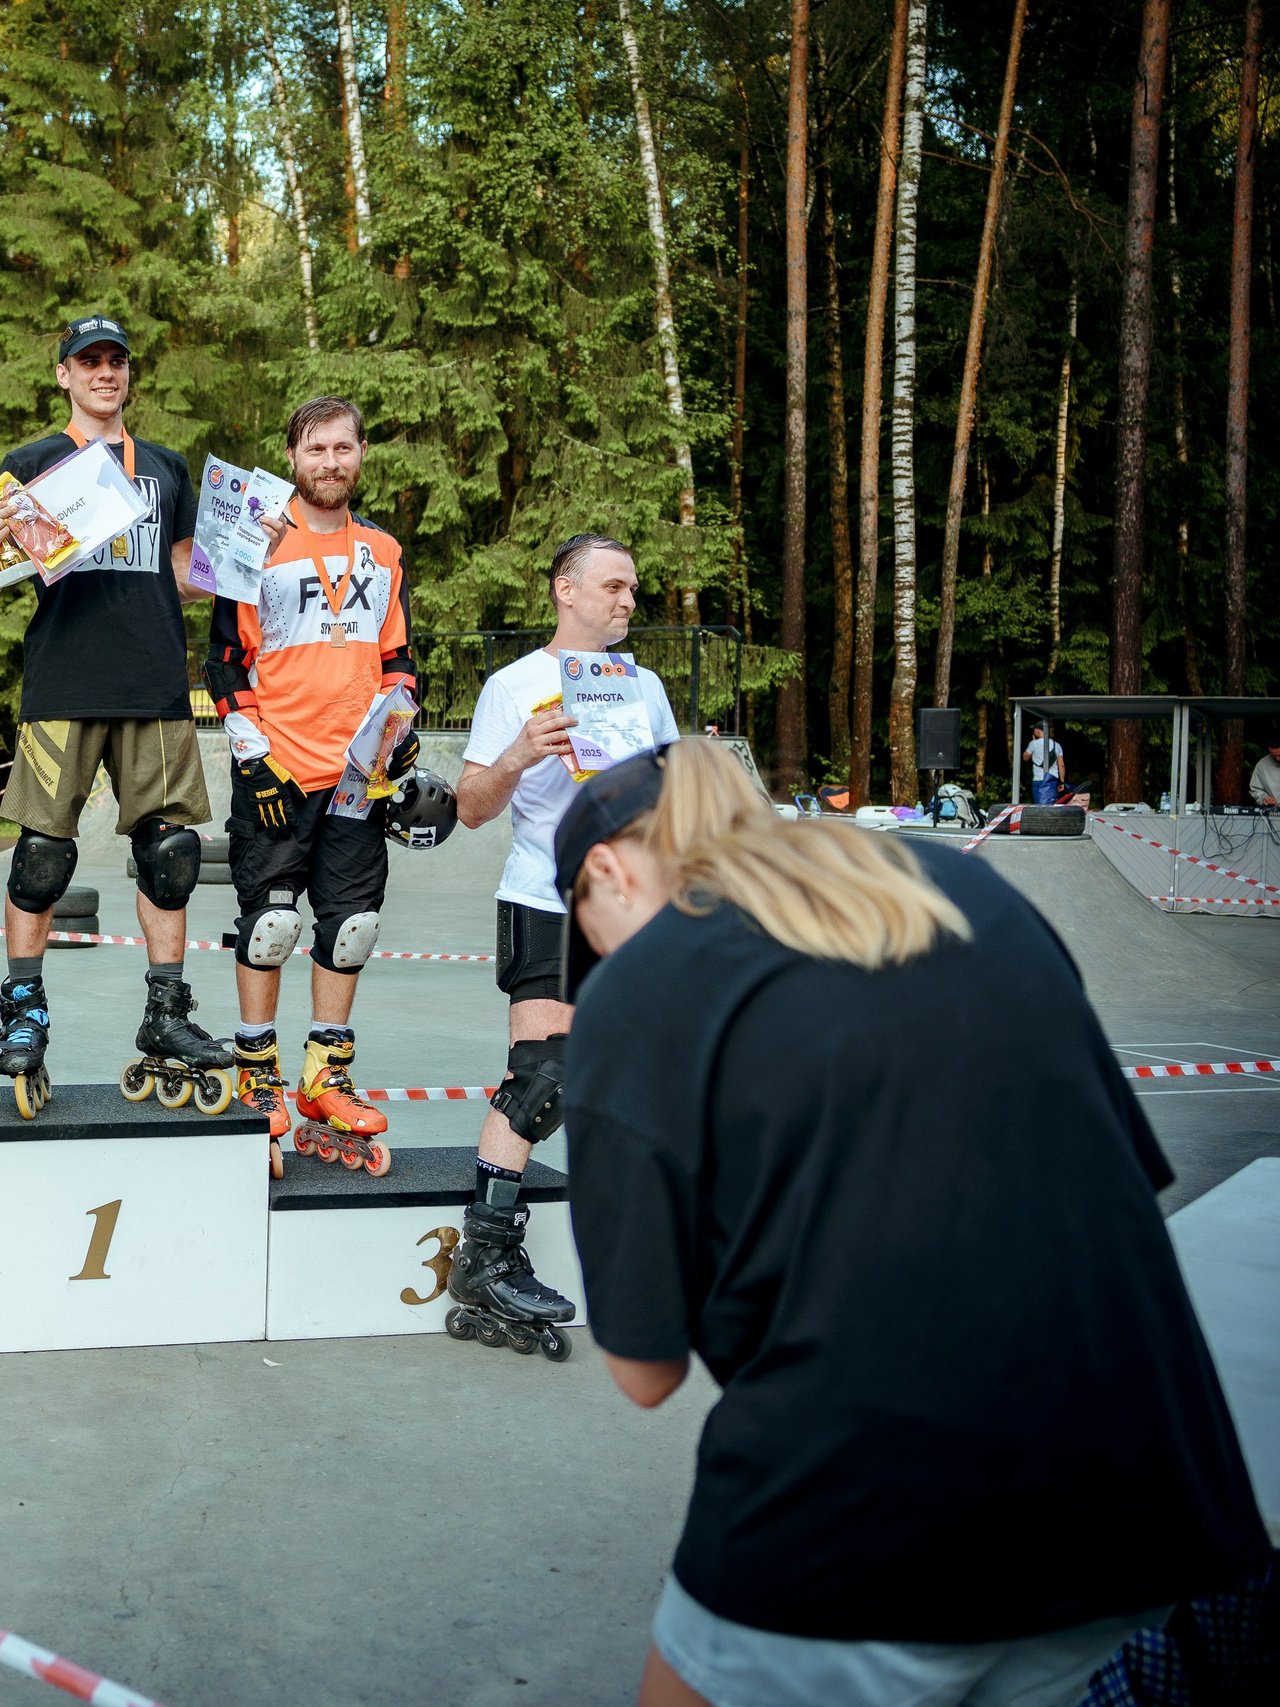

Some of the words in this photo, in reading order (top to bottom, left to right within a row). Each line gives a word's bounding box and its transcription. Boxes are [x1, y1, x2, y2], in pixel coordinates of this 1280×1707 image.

[55, 497, 86, 521] ФИКАТ
[211, 496, 241, 514] ГРАМО
[193, 559, 210, 574] 2025
[576, 693, 625, 702] ГРАМОТА
[580, 748, 602, 758] 2025
[69, 1199, 122, 1280] 1
[400, 1226, 461, 1305] 3
